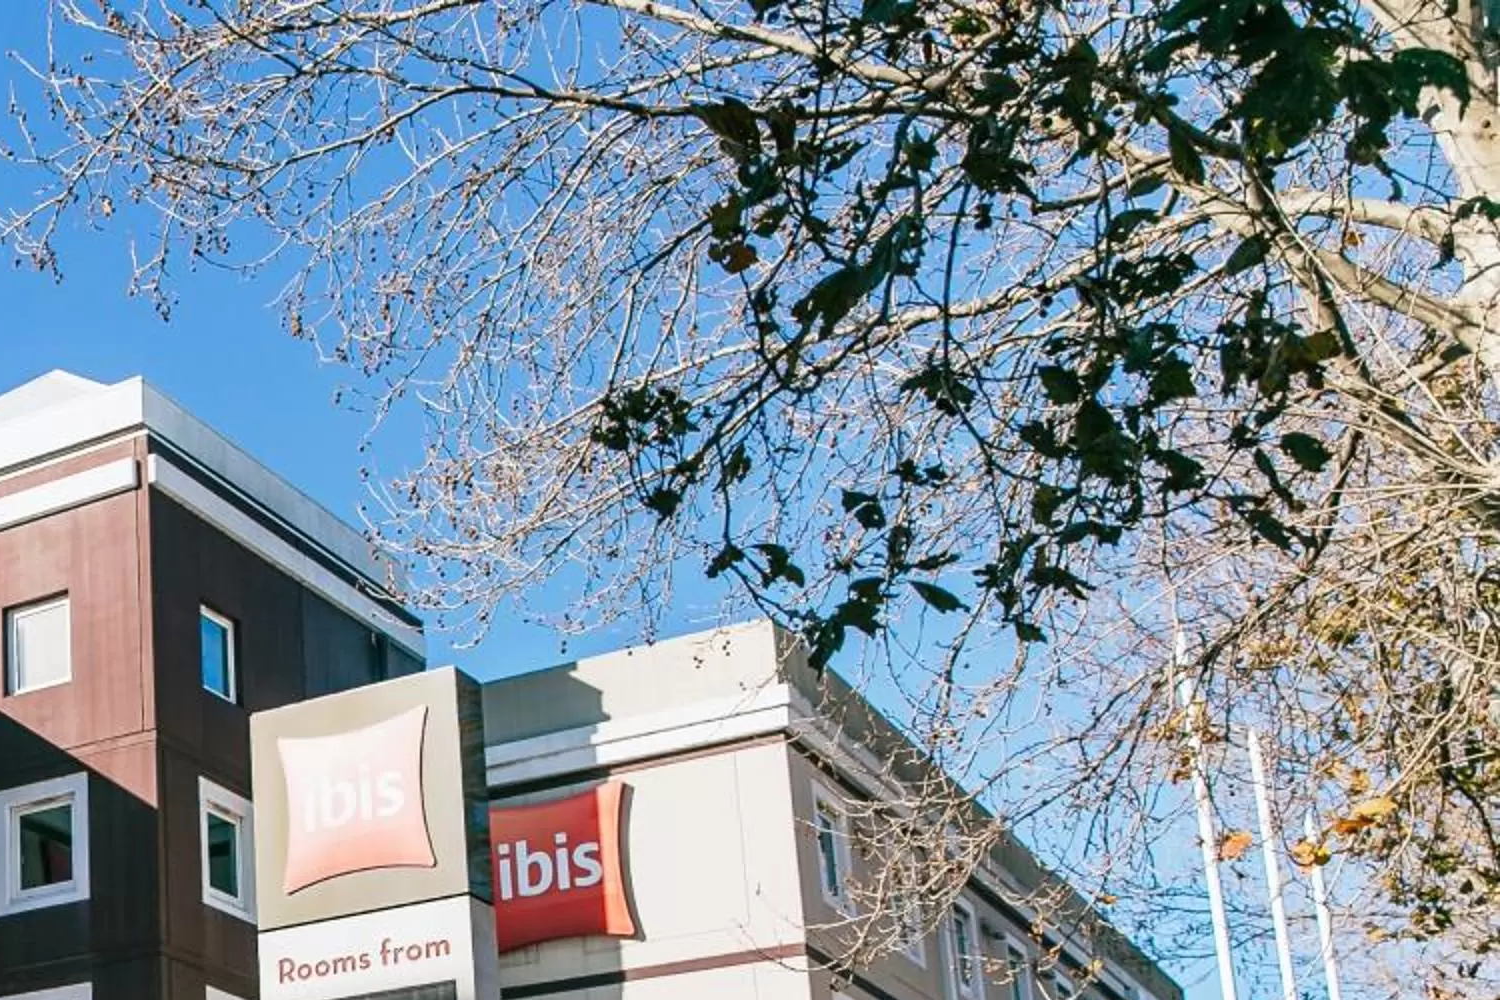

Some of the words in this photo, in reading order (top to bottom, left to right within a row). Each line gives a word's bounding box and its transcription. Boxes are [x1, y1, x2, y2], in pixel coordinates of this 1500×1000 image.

[301, 763, 405, 833] ibis
[497, 832, 603, 900] ibis
[278, 952, 371, 984] Rooms
[380, 937, 451, 966] from
